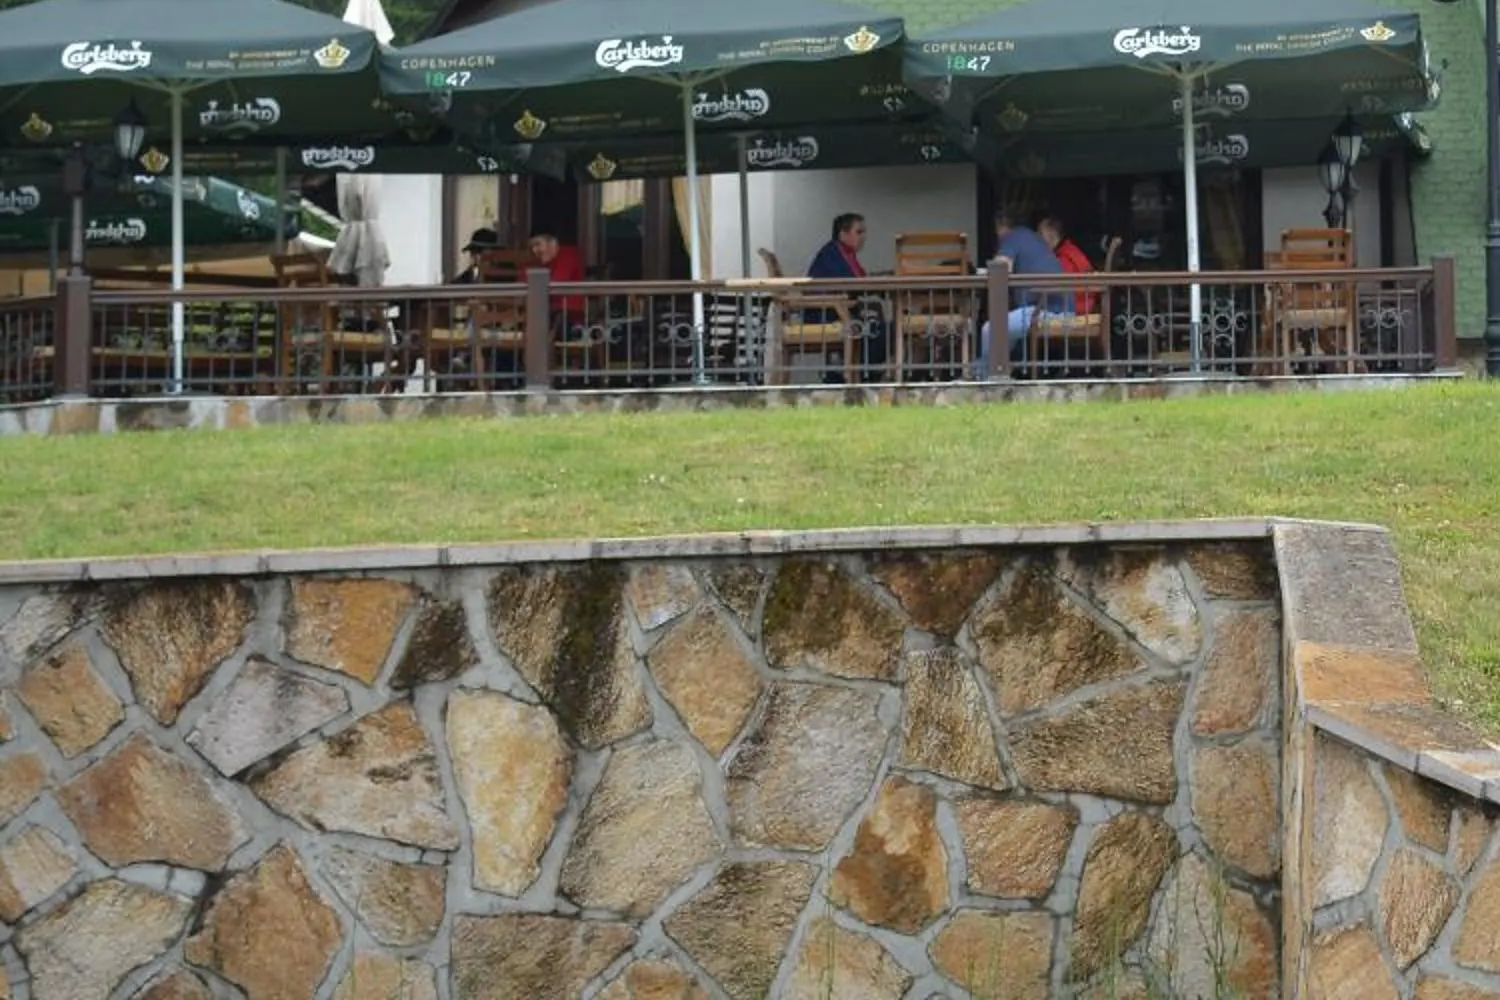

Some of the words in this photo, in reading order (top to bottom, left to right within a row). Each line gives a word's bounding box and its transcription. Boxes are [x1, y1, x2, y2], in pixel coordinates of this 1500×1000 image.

[922, 39, 1016, 54] COPENHAGEN
[1113, 26, 1201, 57] Carlsberg
[61, 40, 152, 74] Carlsberg
[594, 35, 683, 72] Carlsberg
[401, 55, 496, 70] COPENHAGEN
[946, 56, 990, 72] 1847
[425, 71, 471, 88] 1847
